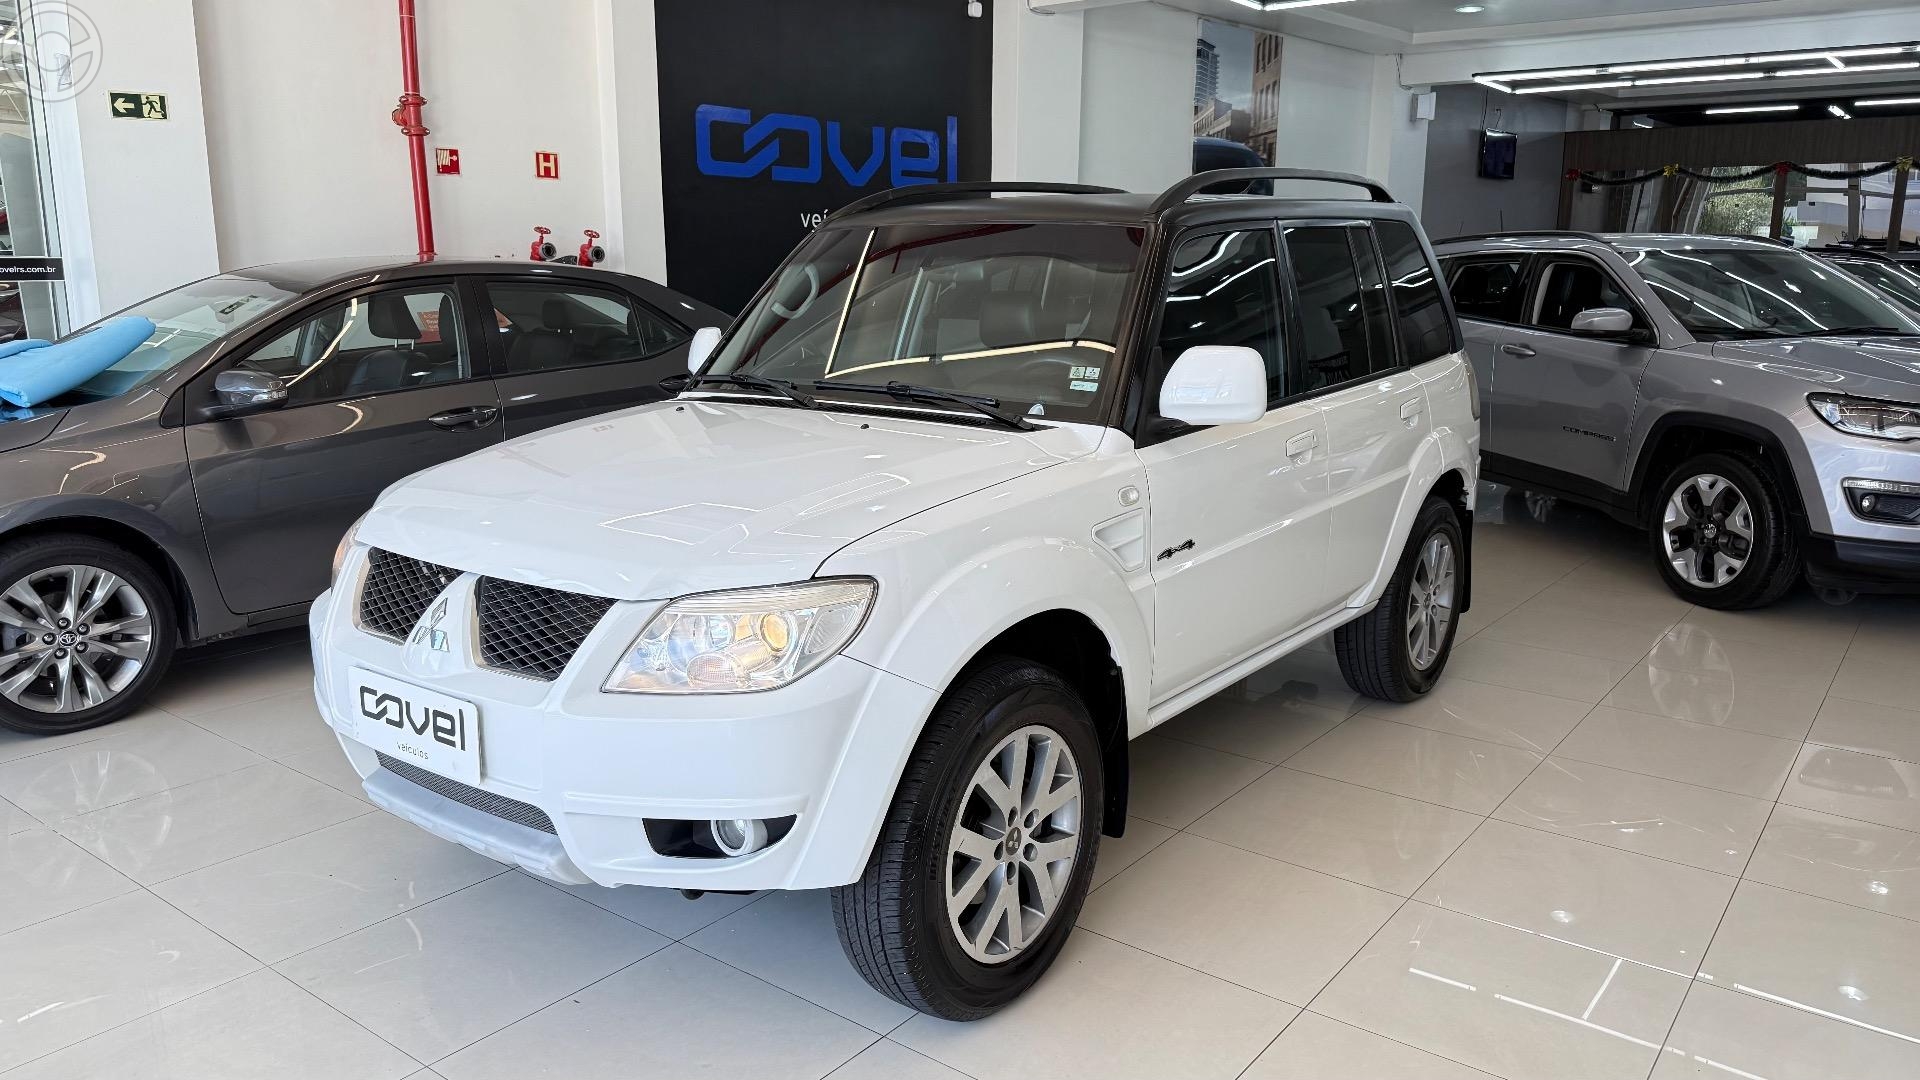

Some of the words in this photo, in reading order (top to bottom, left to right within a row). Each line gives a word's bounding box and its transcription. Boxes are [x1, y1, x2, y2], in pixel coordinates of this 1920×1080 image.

[538, 153, 556, 177] H
[695, 103, 958, 187] covel
[1562, 425, 1615, 442] COMPASS
[360, 685, 466, 752] covel
